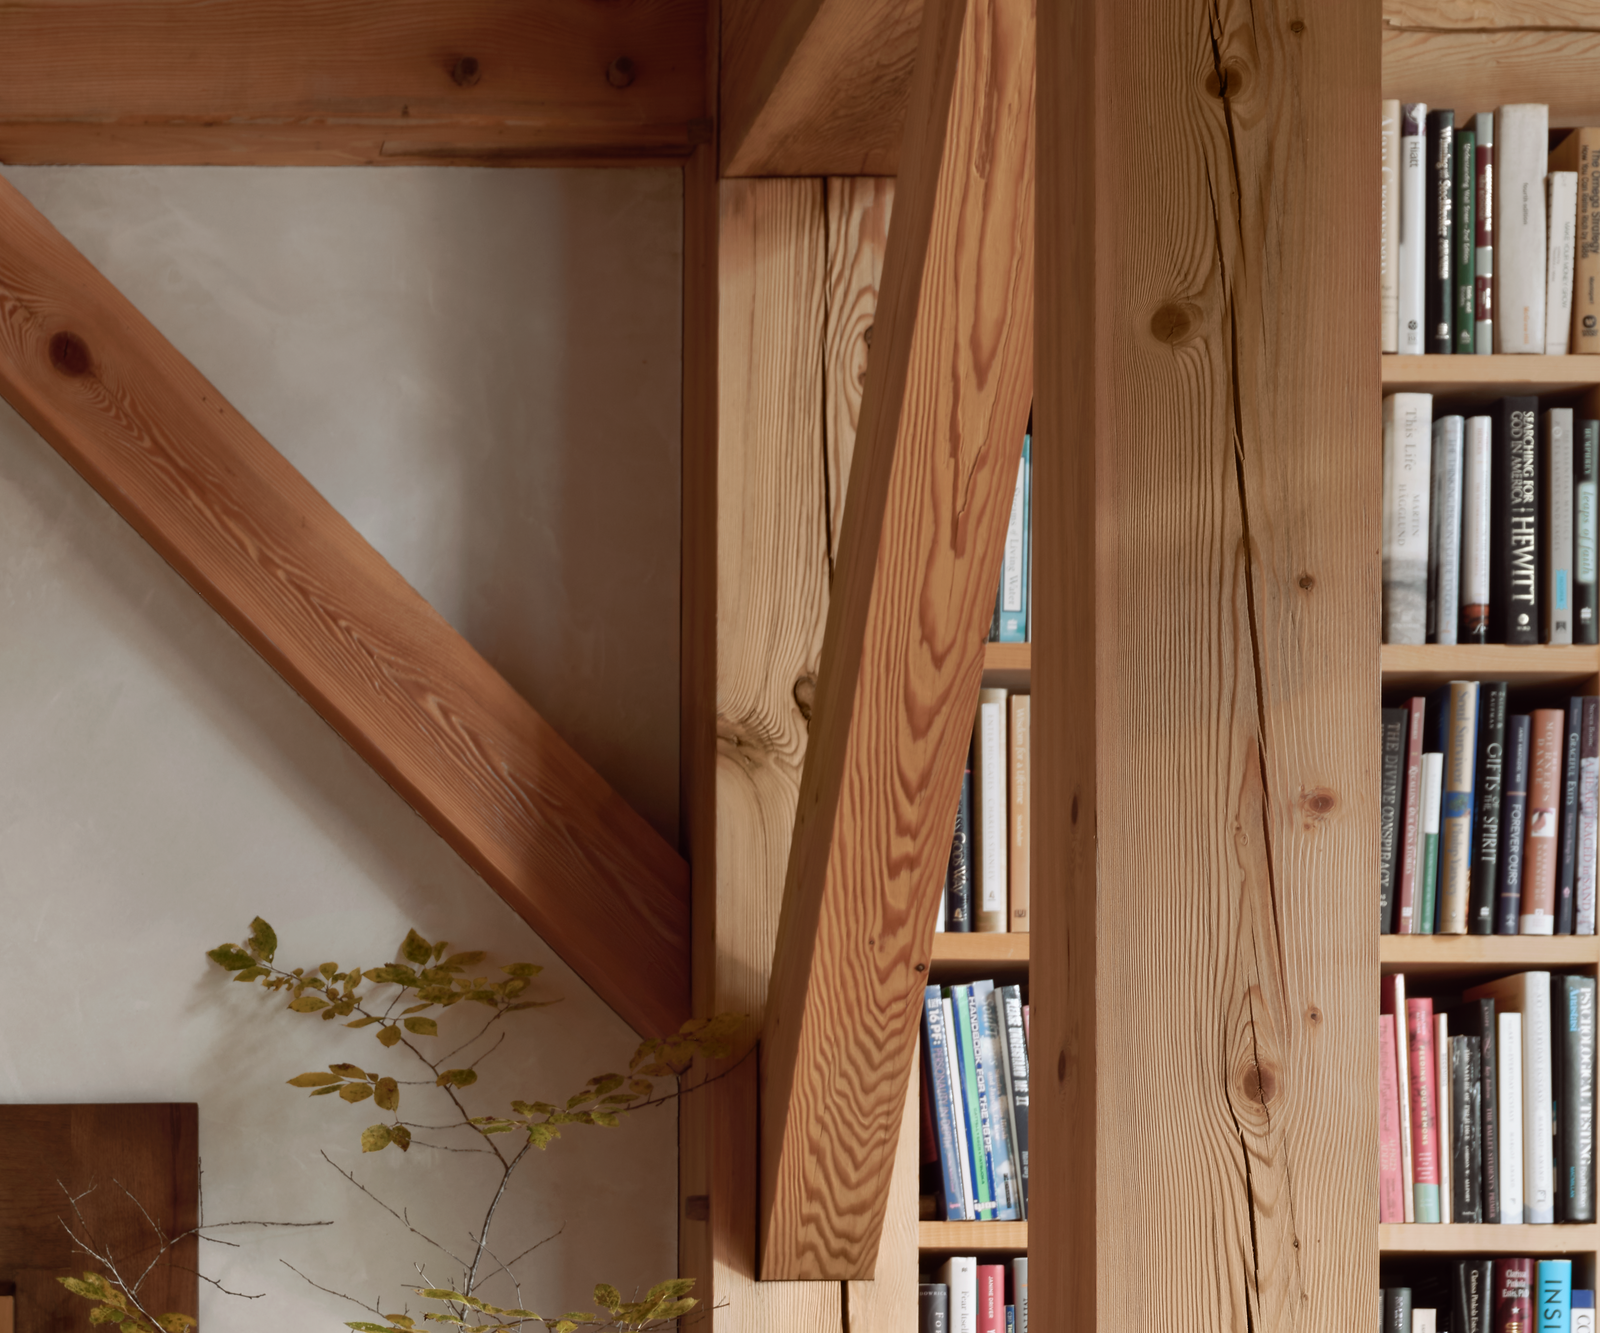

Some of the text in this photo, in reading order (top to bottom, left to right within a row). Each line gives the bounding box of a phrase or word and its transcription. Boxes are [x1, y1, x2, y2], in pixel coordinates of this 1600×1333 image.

[1410, 141, 1419, 168] Hiatt
[1404, 408, 1417, 471] This Life
[1511, 411, 1522, 505] GOD IN AMERICA
[1523, 411, 1534, 504] SEARCHING FOR
[1511, 515, 1535, 605] HEWITT
[1454, 690, 1470, 784] Soul Survivor
[1566, 732, 1579, 806] GRACEFUL EXITS
[1381, 722, 1400, 887] THE DIVINE CONSPIRACY
[1508, 804, 1522, 885] FOREVER OURS
[1419, 1046, 1427, 1082] FEEDING
[1420, 1085, 1428, 1107] YOUR
[1580, 988, 1592, 1165] PSYCHOLOGICAL TESTING
